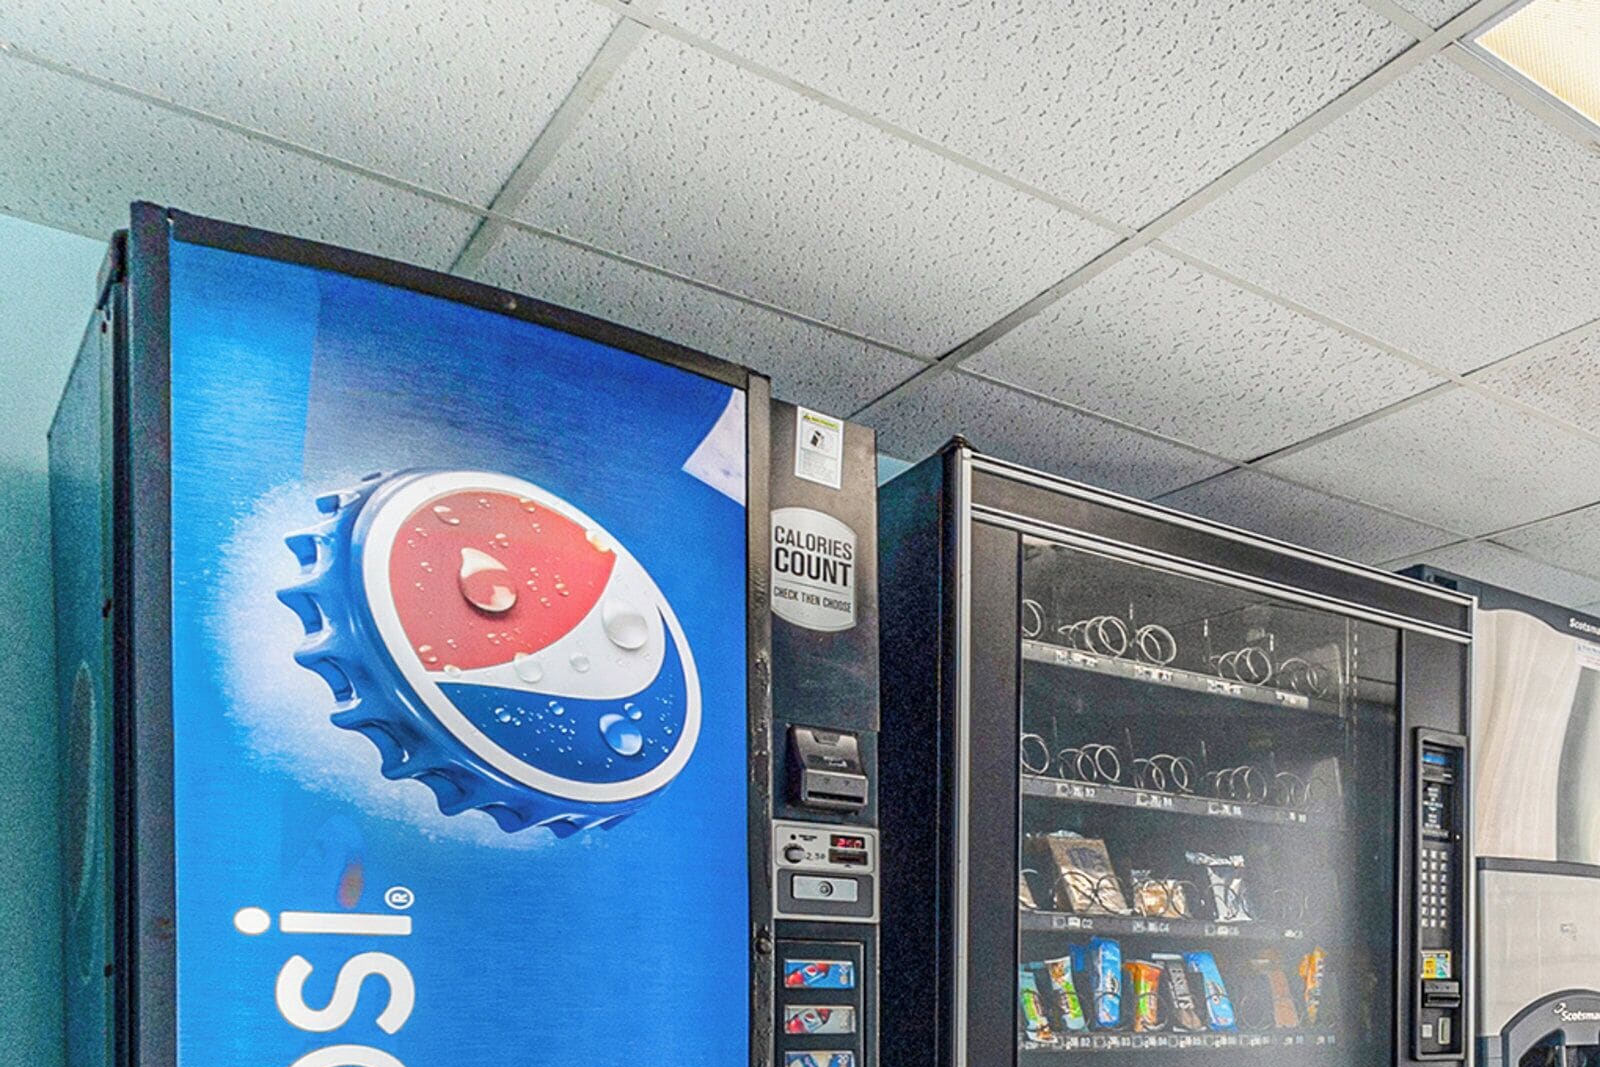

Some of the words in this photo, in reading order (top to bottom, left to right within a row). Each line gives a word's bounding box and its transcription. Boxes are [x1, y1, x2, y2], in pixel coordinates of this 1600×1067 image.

[775, 525, 852, 560] CALORIES
[774, 547, 852, 587] COUNT
[774, 586, 798, 601] CHECK
[801, 592, 820, 606] THEN
[822, 598, 852, 613] CHOOSE
